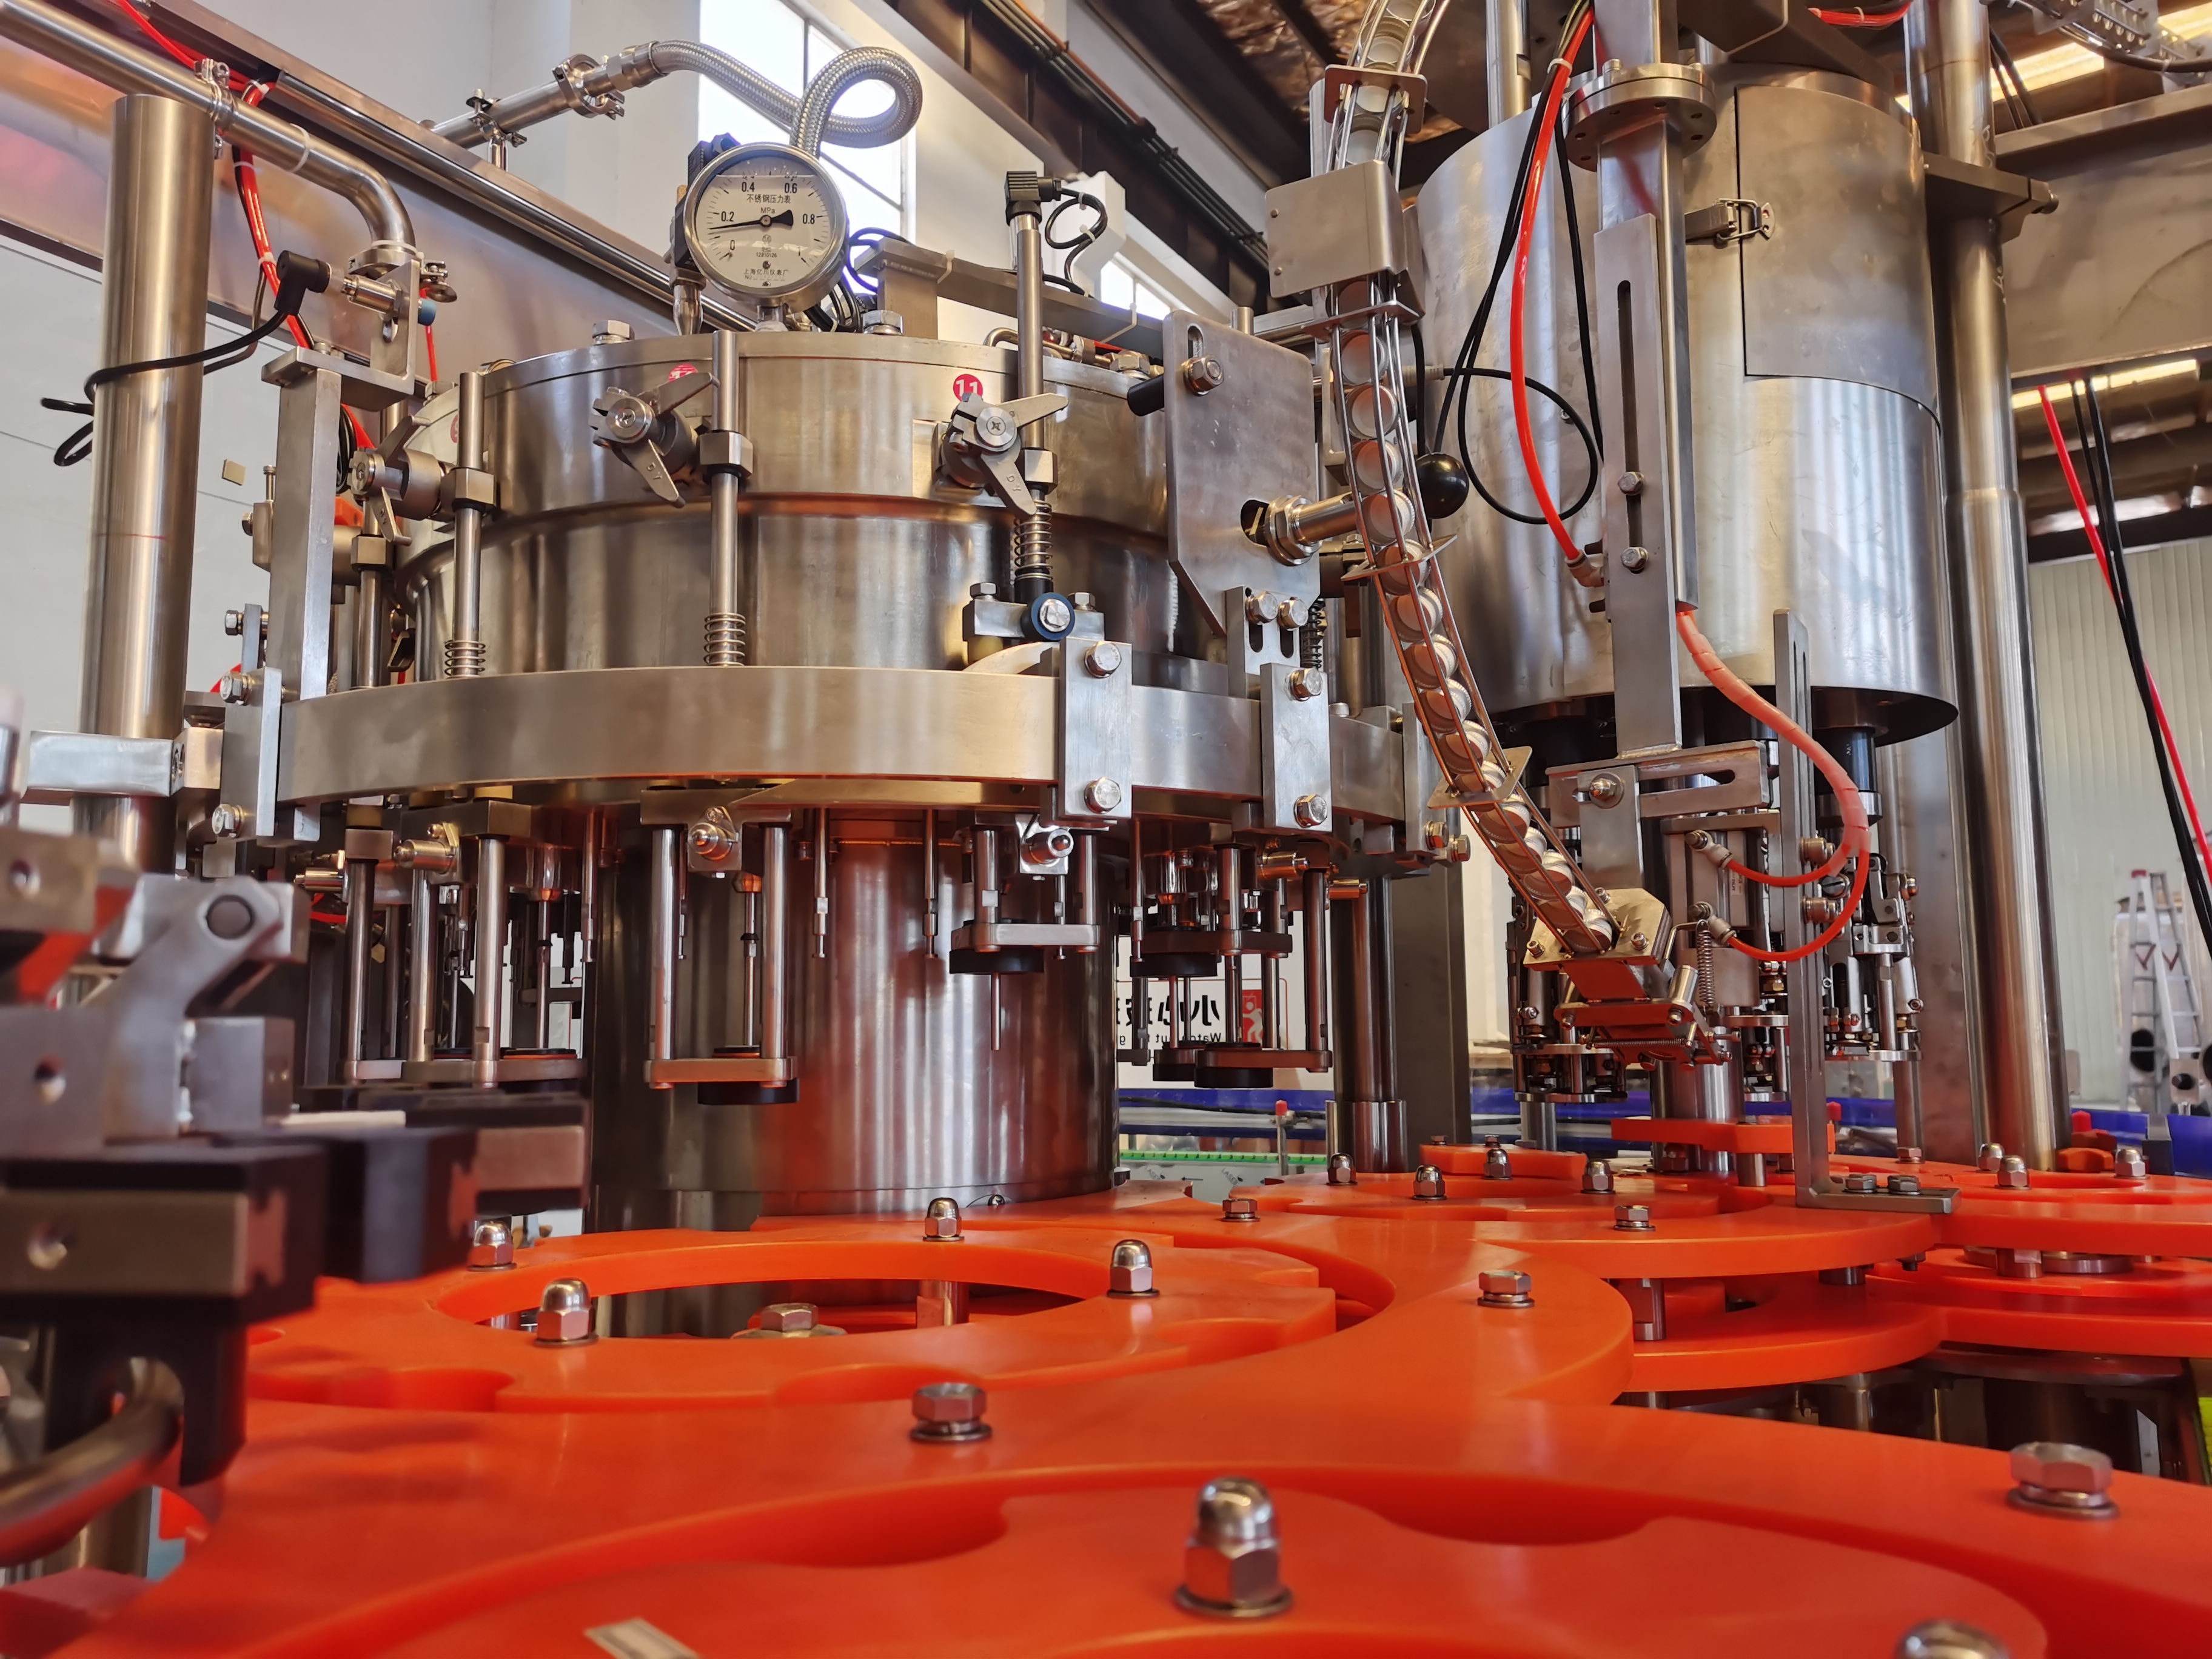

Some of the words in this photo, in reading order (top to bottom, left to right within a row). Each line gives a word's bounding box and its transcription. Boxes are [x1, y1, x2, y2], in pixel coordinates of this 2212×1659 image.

[742, 181, 755, 192] 0.4
[784, 183, 797, 193] 0.6
[746, 194, 791, 204] 不锈钢压力表
[721, 212, 734, 222] 0.2
[802, 213, 815, 224] 0.8
[729, 240, 735, 250] 0
[956, 379, 978, 397] 11
